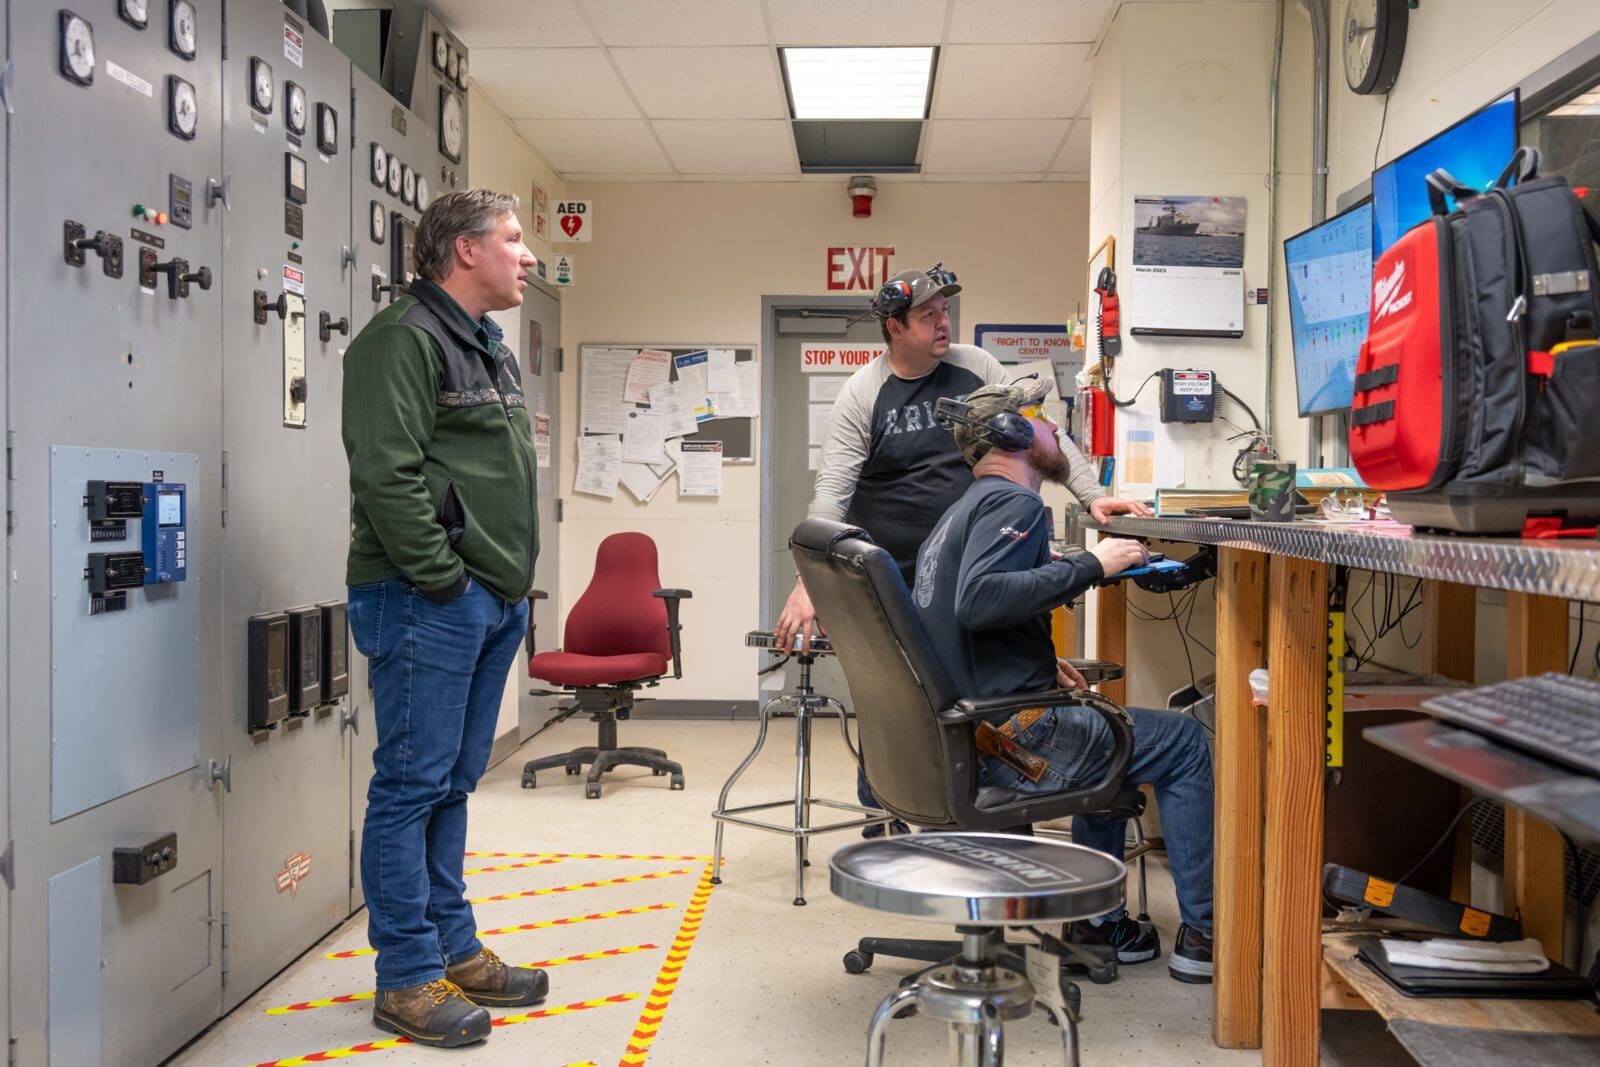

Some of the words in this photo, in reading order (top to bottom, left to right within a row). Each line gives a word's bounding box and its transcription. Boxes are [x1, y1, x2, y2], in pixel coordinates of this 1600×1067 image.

[557, 202, 587, 214] AED
[827, 247, 896, 291] EXIT
[1028, 338, 1040, 346] TO
[1019, 347, 1050, 355] CENTER
[805, 350, 835, 365] STOP
[839, 350, 870, 365] YOUR
